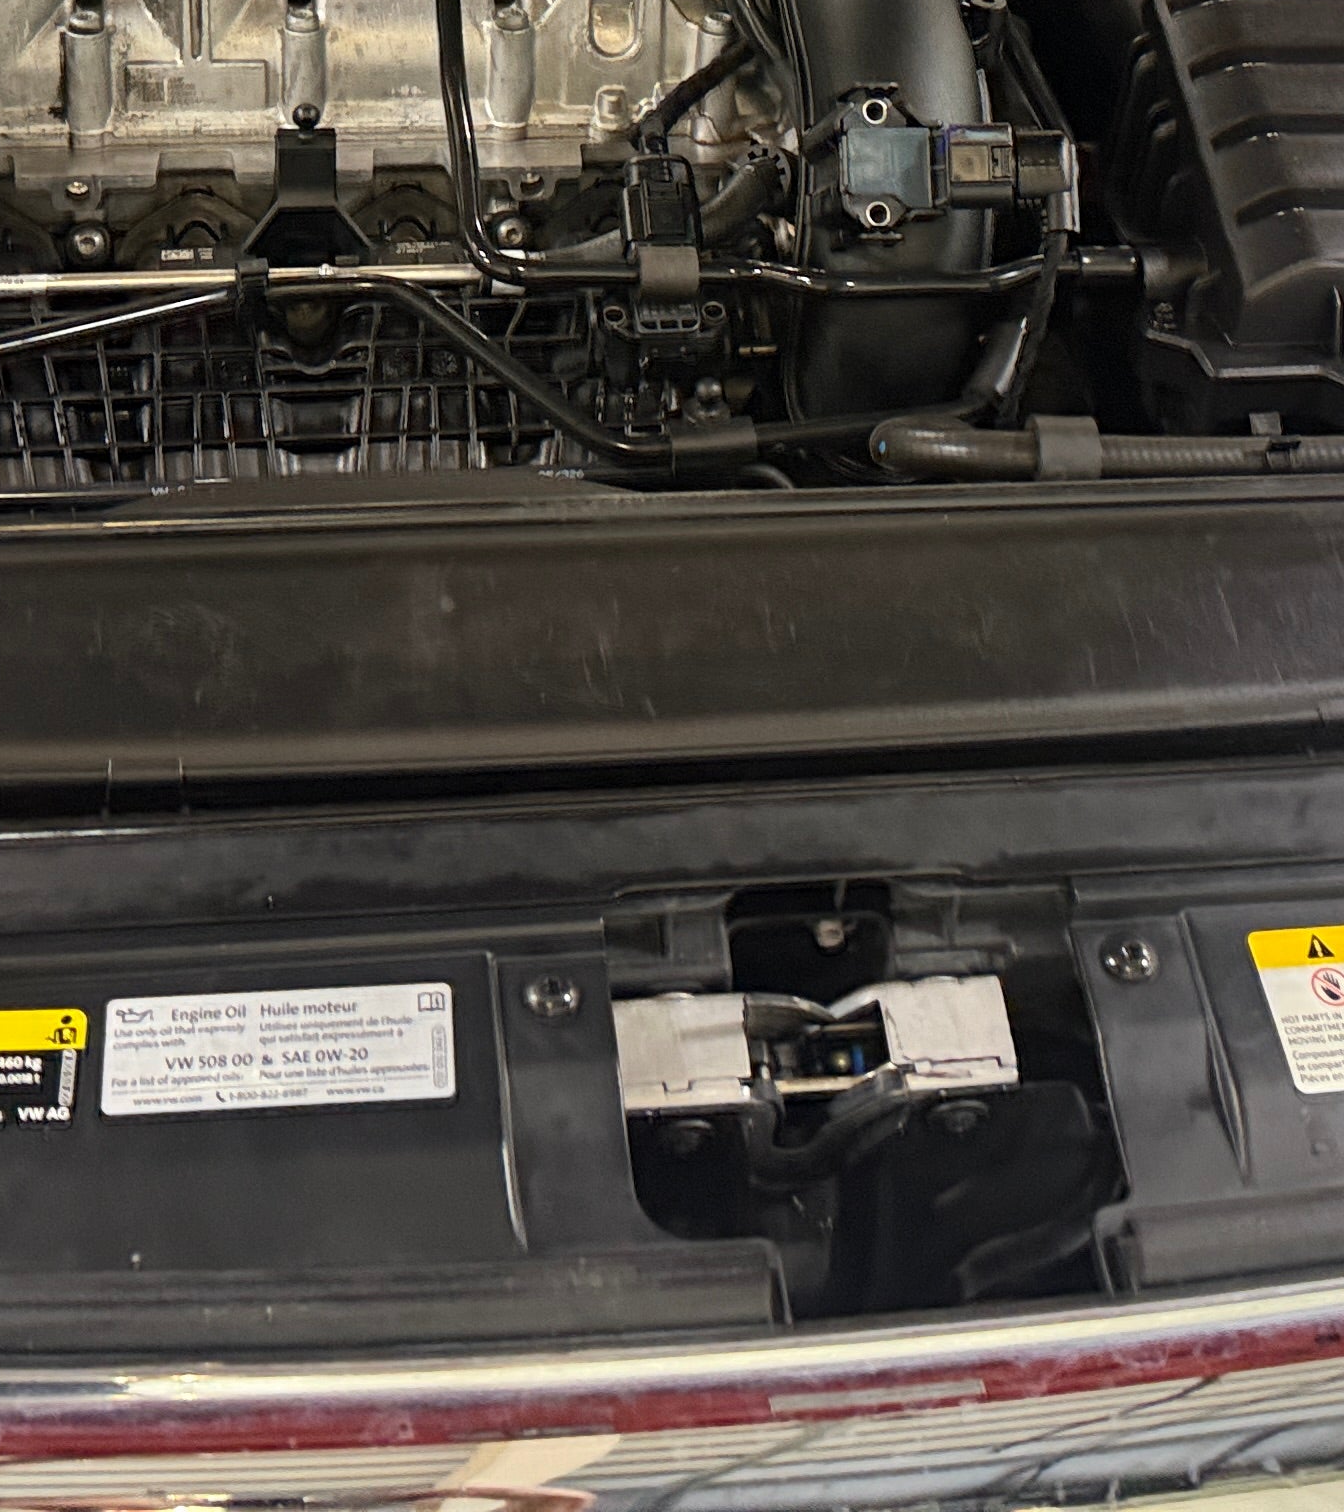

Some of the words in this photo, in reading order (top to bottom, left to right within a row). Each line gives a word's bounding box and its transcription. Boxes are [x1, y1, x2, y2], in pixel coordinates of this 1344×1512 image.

[171, 1005, 223, 1025] Engine
[224, 1003, 248, 1019] Oil
[260, 1001, 300, 1019] Huile
[302, 1000, 358, 1016] moteur
[299, 1017, 364, 1031] uniquement
[365, 1016, 380, 1027] de
[1281, 1015, 1300, 1025] HOT
[1301, 1013, 1331, 1023] PARTS
[1332, 1011, 1343, 1021] IN
[113, 1027, 134, 1038] Use
[135, 1026, 158, 1039] only
[159, 1025, 173, 1036] oil
[174, 1024, 196, 1035] that
[197, 1022, 246, 1036] expressly
[112, 1039, 161, 1052] complies
[161, 1037, 187, 1048] with
[259, 1034, 277, 1046] qui
[1288, 1034, 1327, 1046] MOVING
[24, 1056, 43, 1073] kg
[164, 1055, 195, 1071] VW
[197, 1054, 229, 1070] 508
[231, 1052, 255, 1068] 00
[261, 1053, 274, 1066] &
[281, 1049, 311, 1065] SAE
[314, 1046, 370, 1063] 0W-20
[1296, 1061, 1306, 1072] le
[111, 1076, 129, 1088] For
[129, 1077, 138, 1087] a
[138, 1075, 156, 1087] list
[157, 1074, 170, 1086] of
[170, 1072, 221, 1087] approved
[259, 1068, 283, 1081] Pour
[283, 1068, 305, 1079] une
[305, 1065, 328, 1078] liste
[16, 1105, 45, 1122] VW
[46, 1104, 72, 1121] AG
